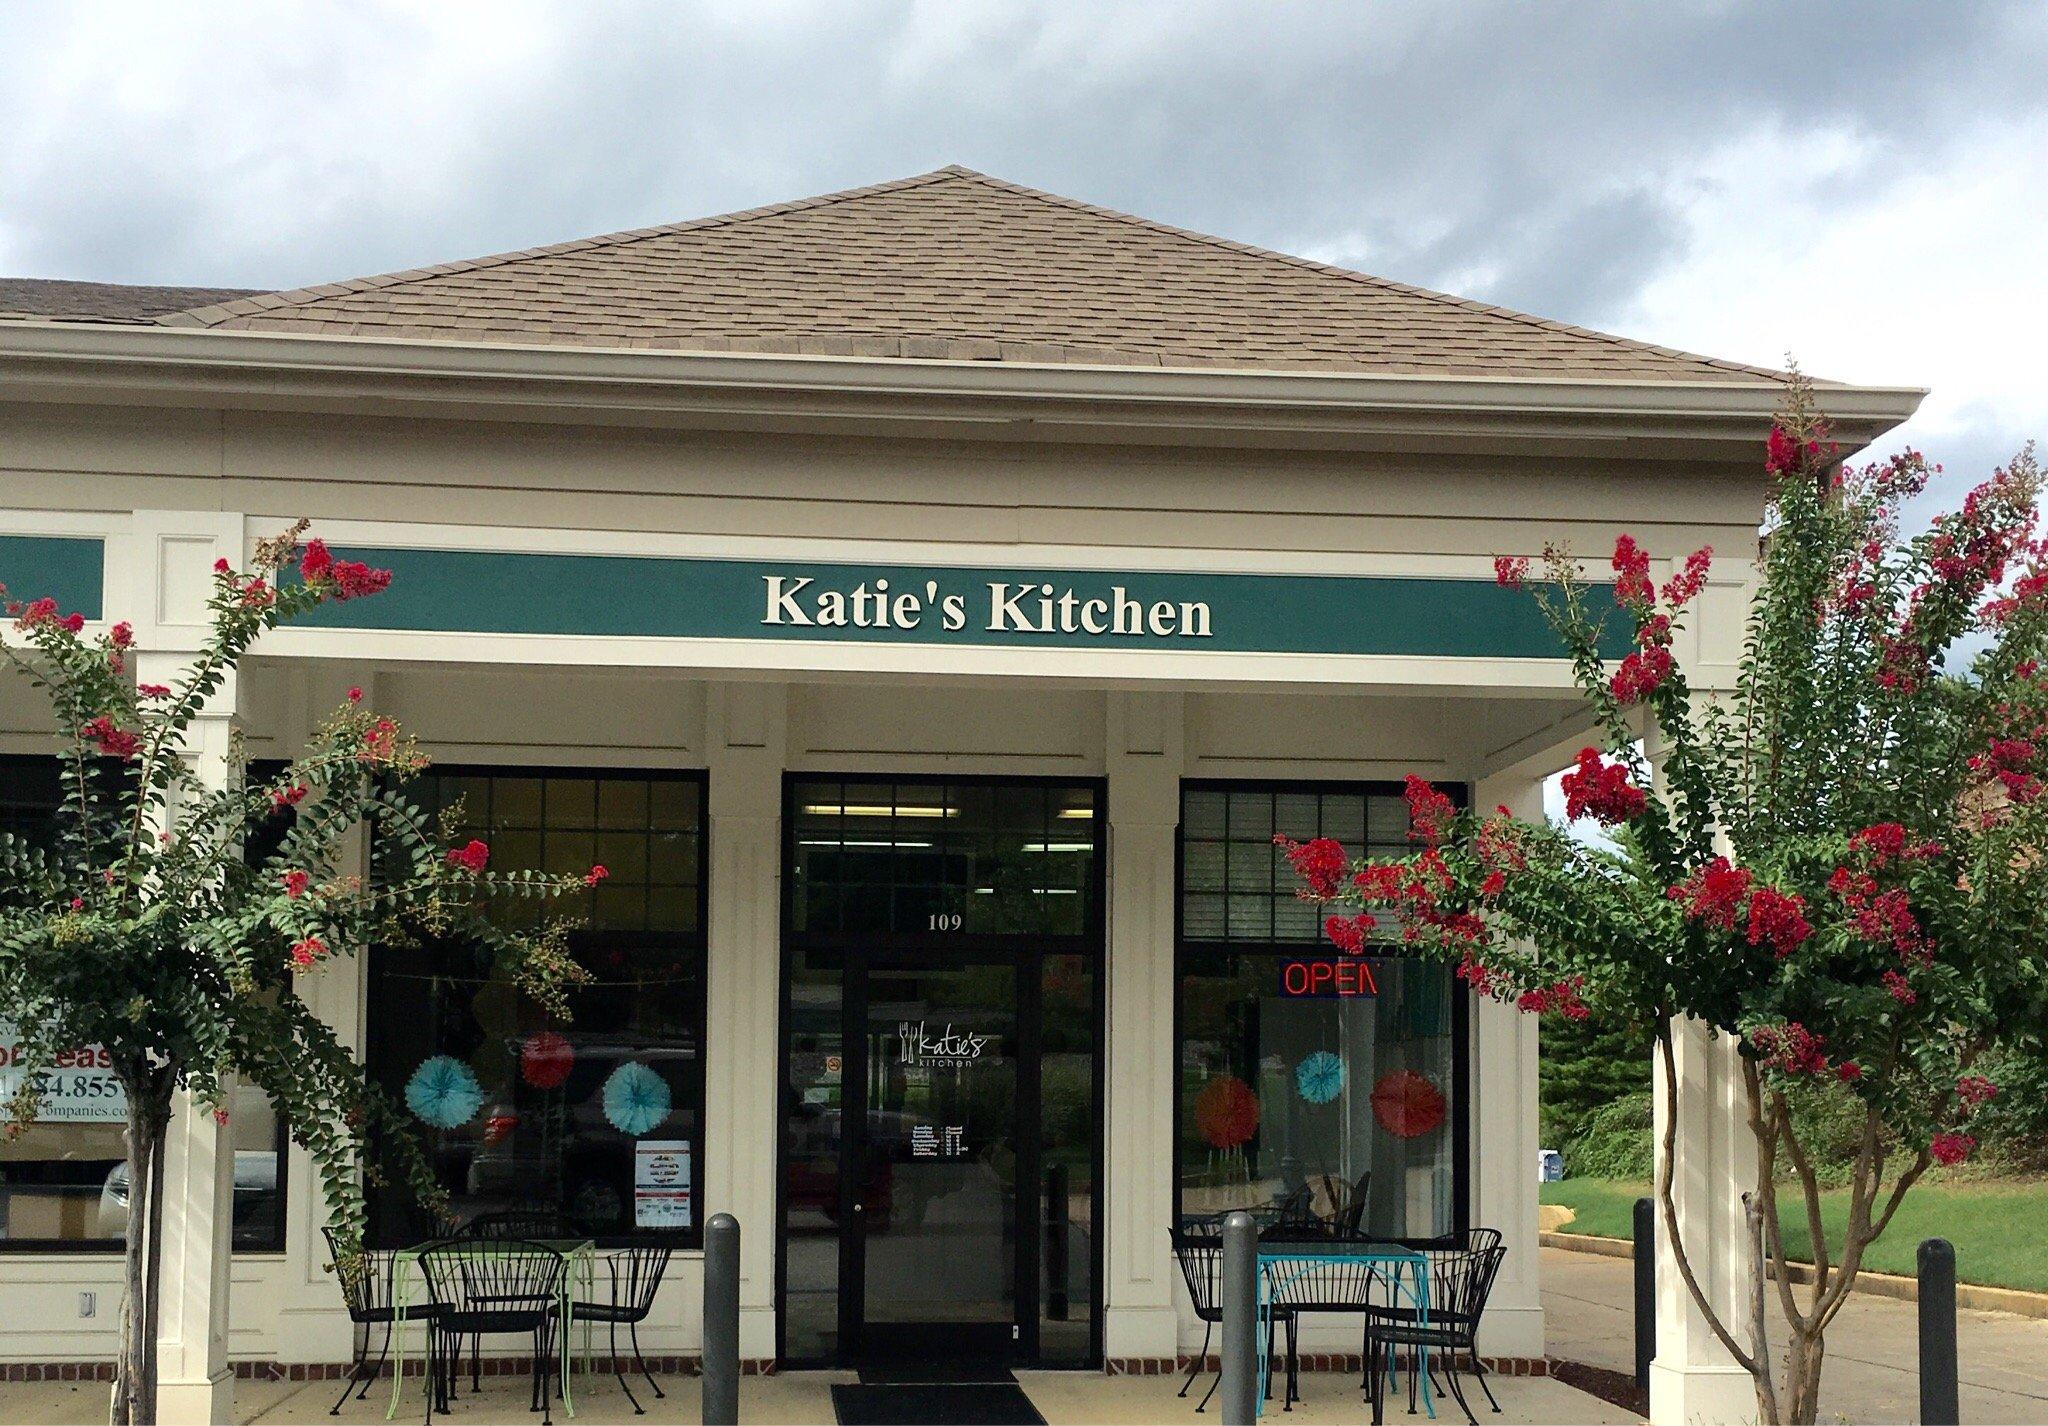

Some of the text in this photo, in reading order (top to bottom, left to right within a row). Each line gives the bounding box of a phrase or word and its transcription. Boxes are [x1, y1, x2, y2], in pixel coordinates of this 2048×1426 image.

[761, 575, 1214, 637] Katie's Kitchen
[928, 914, 962, 931] 109
[1284, 962, 1379, 995] OPEN
[54, 1046, 113, 1069] eas
[919, 1058, 972, 1068] kitchen
